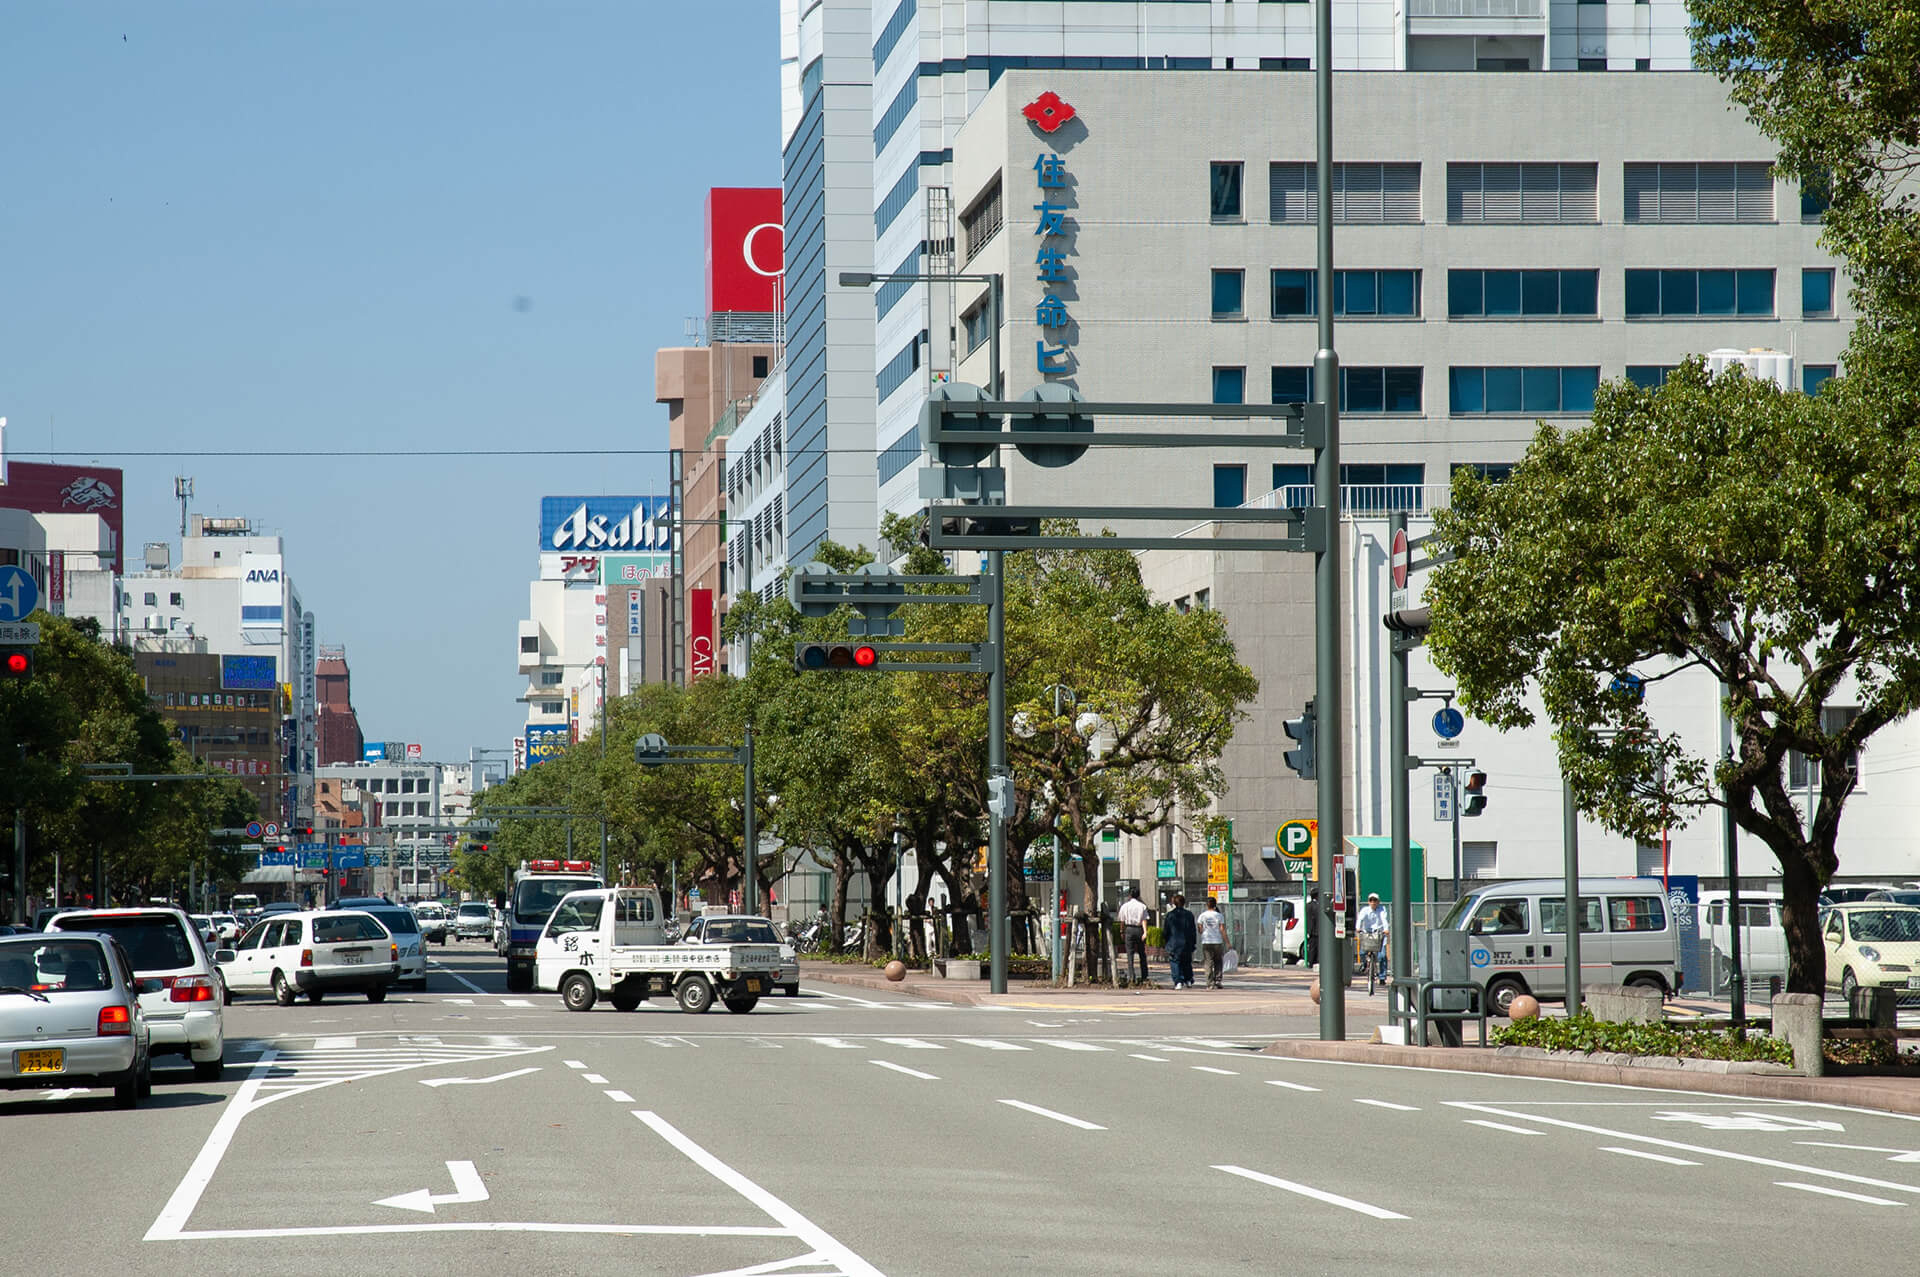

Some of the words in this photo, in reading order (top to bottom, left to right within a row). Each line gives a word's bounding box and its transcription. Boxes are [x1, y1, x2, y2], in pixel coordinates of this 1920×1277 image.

[1033, 152, 1067, 374] 住友生命ビ
[552, 502, 669, 549] Asahi
[560, 556, 599, 573] アサ
[246, 569, 279, 583] ANA
[0, 627, 37, 641] 両を除く
[530, 745, 566, 757] NOVA
[1287, 827, 1307, 852] P
[1289, 861, 1312, 873] リパー
[1493, 951, 1512, 959] NTT
